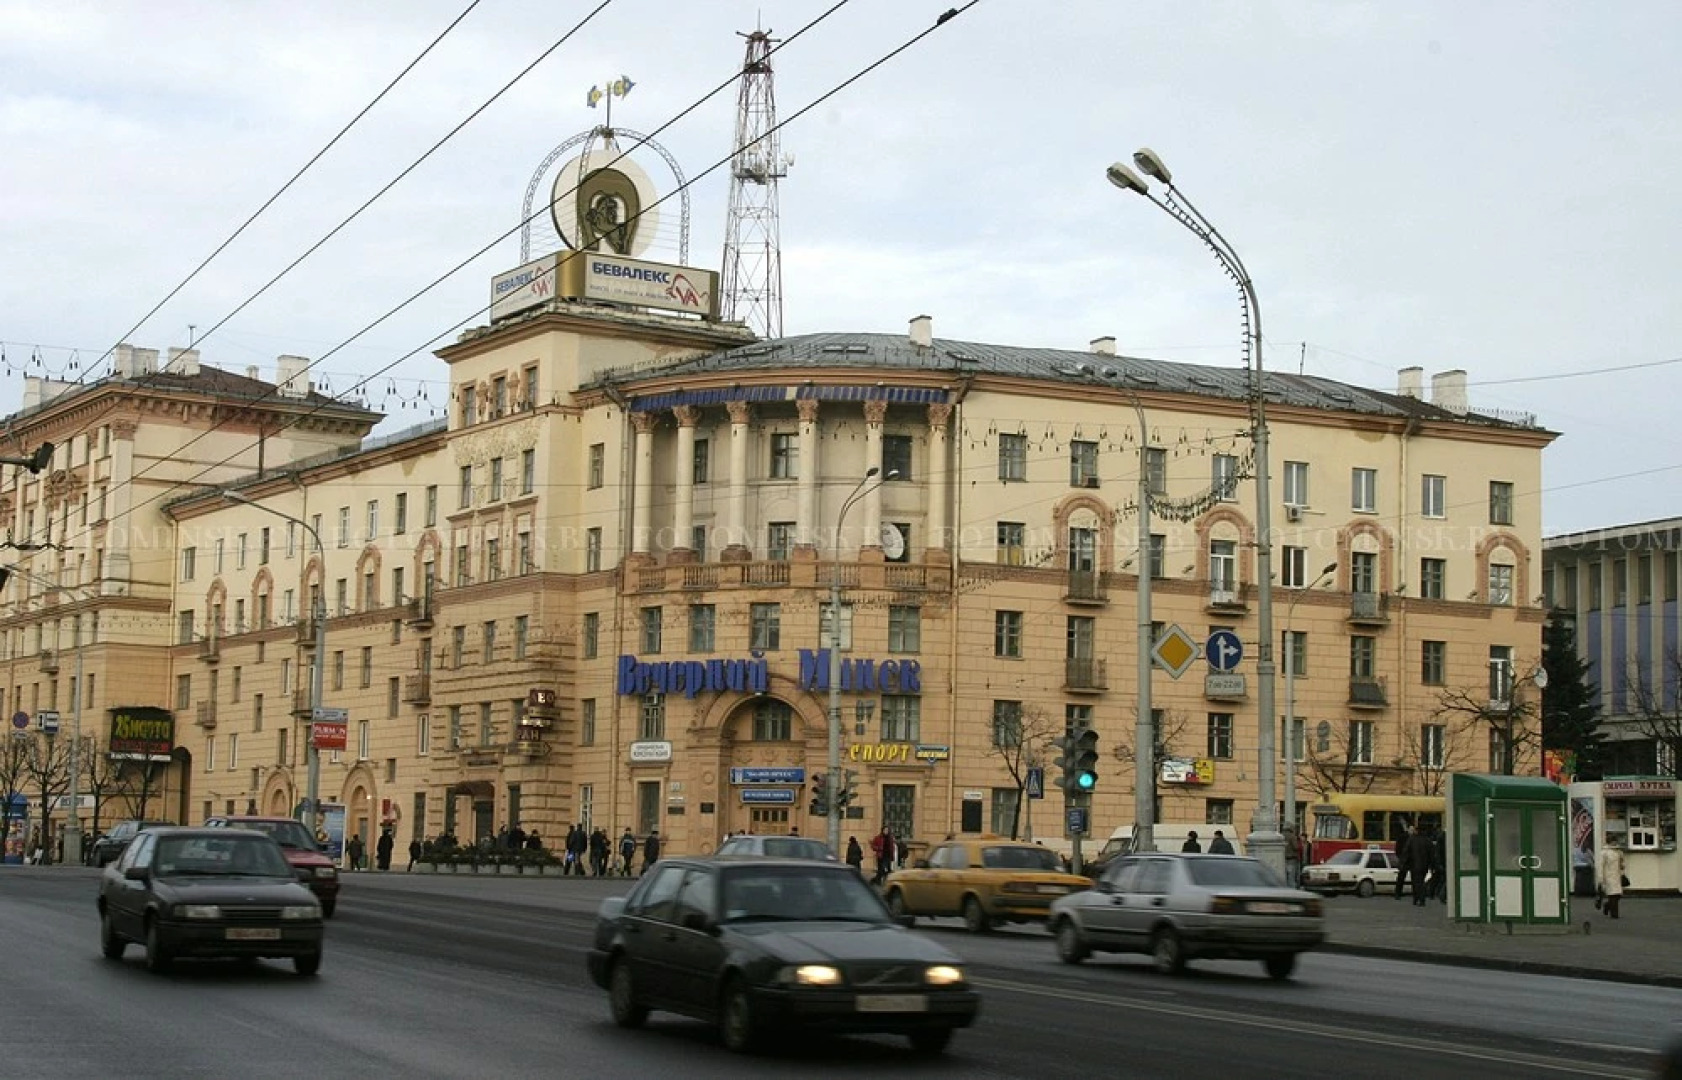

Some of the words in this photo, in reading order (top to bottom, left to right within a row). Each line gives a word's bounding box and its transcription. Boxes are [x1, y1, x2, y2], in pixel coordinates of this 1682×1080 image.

[592, 262, 670, 284] БЕВАЛЕКС
[617, 650, 768, 699] Вечерний
[850, 743, 910, 762] СПОРТ
